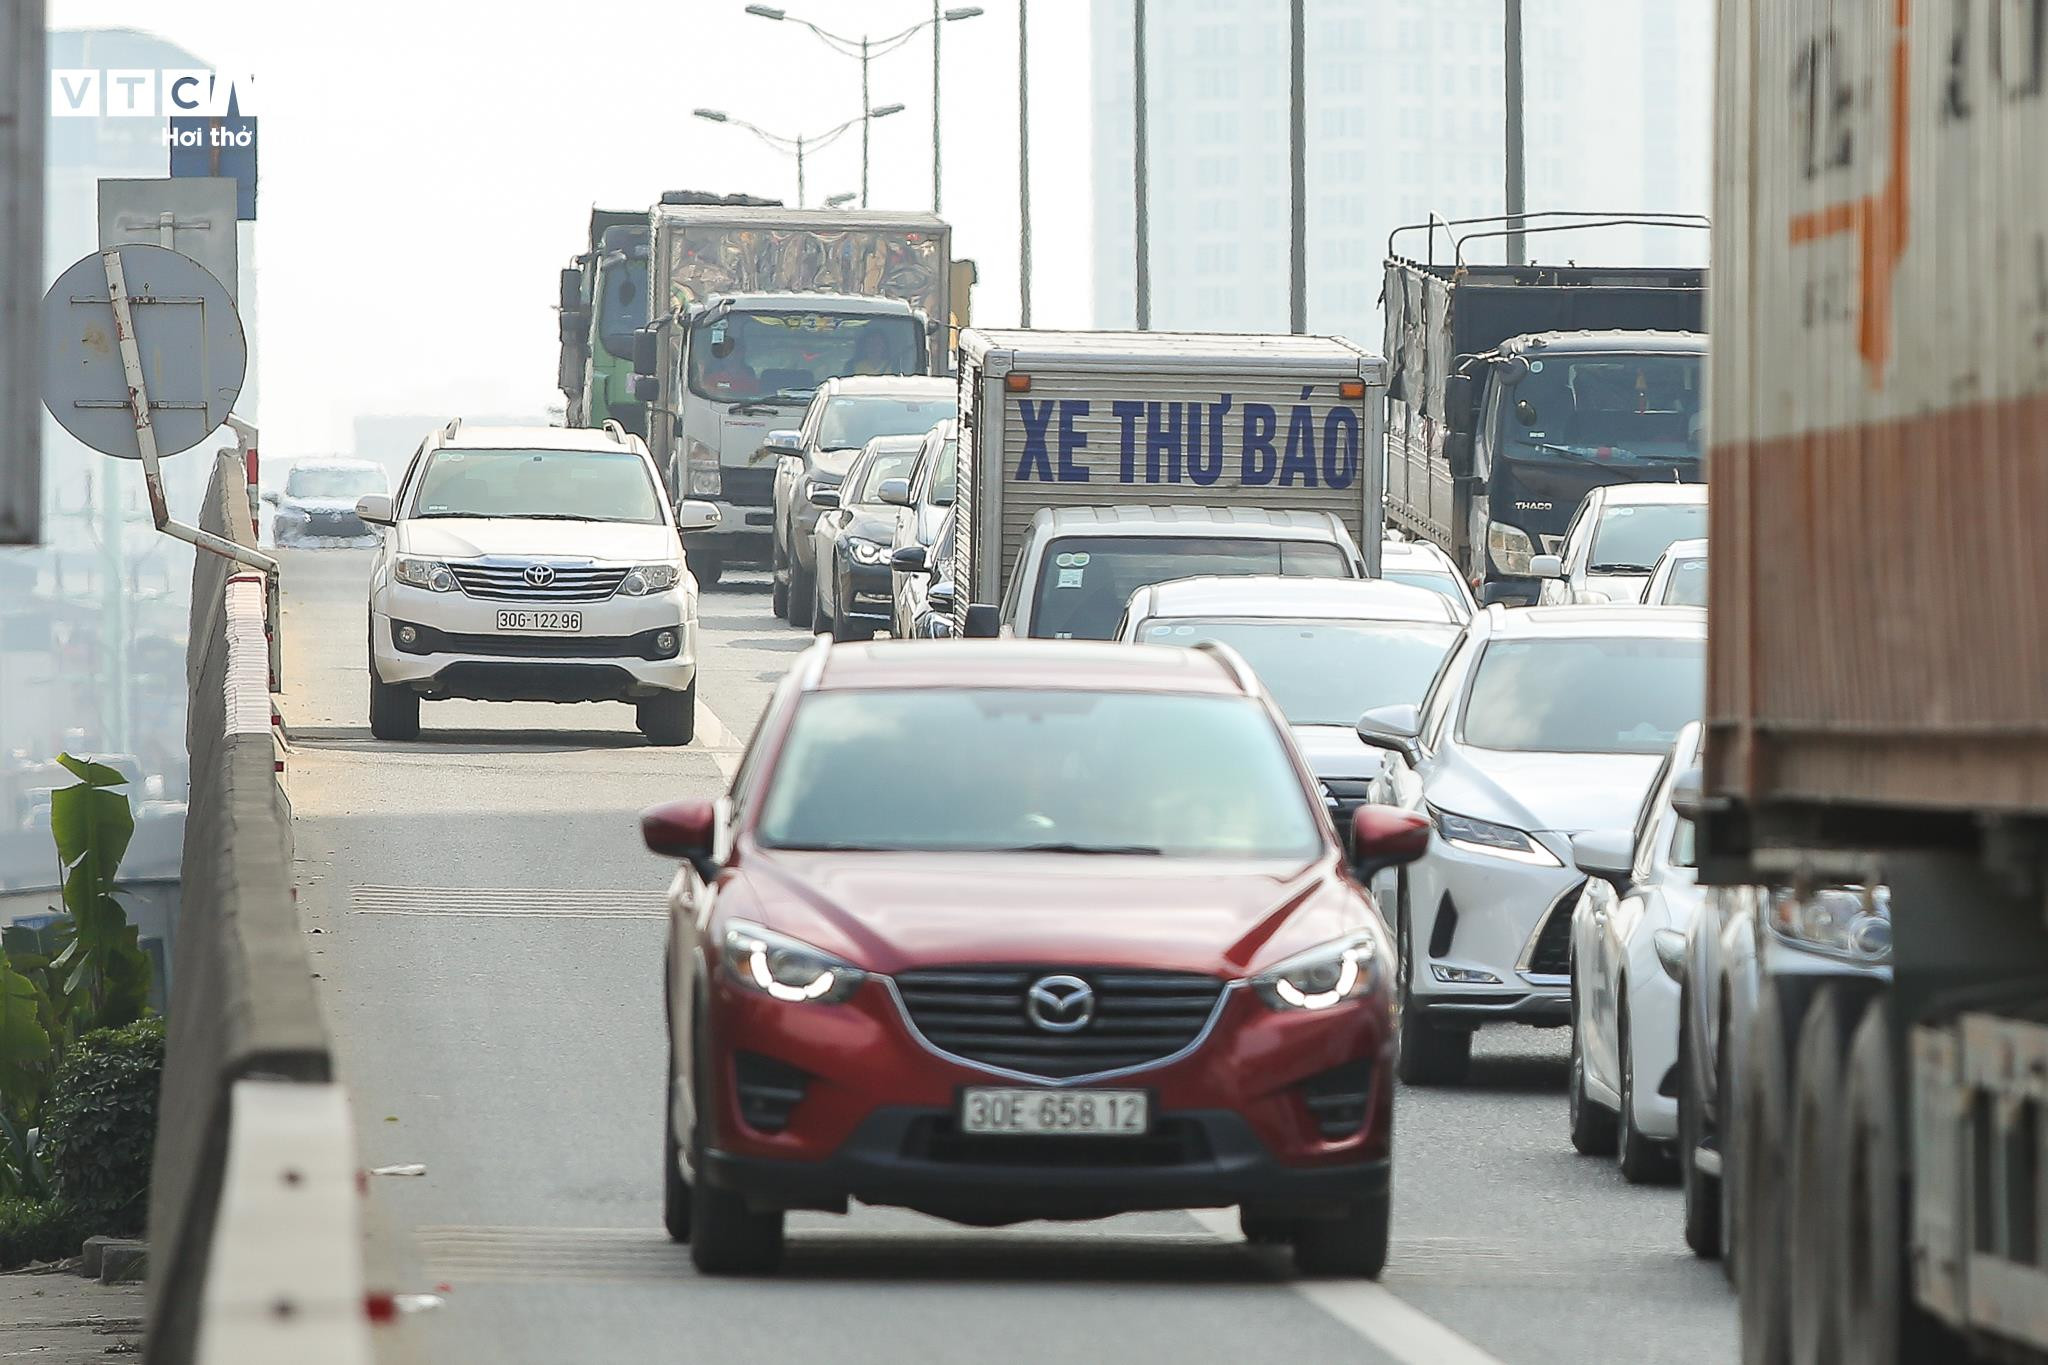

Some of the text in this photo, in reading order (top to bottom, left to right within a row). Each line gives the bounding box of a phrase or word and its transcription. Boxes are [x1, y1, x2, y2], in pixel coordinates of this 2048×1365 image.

[1015, 386, 1358, 489] XE THƯ BÁO
[1515, 501, 1553, 511] THACO
[499, 612, 580, 629] 30G-122.96
[970, 1096, 1138, 1128] 30E-658.12
